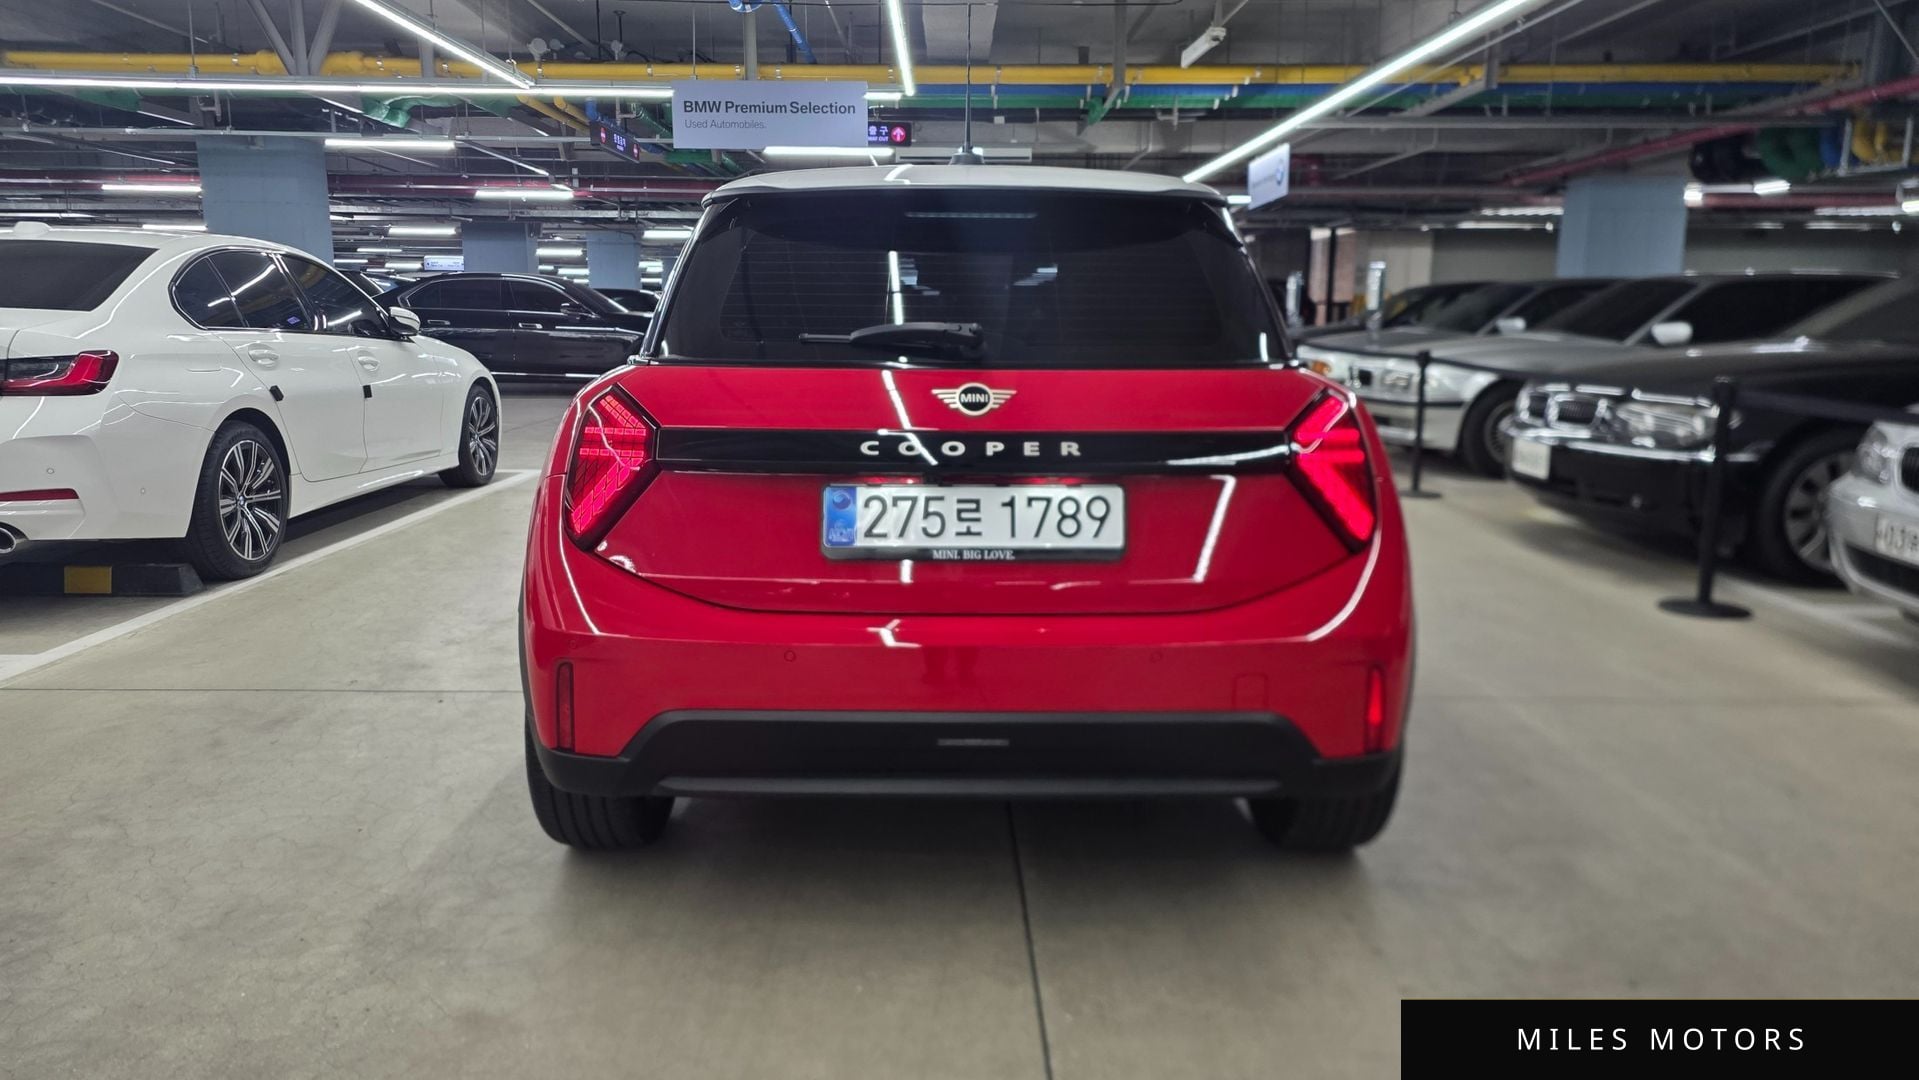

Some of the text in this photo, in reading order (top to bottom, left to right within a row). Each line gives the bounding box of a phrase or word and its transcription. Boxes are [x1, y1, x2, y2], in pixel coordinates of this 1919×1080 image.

[683, 100, 856, 114] BMW Premium Selection
[684, 119, 767, 129] Used Automobiles.
[960, 393, 989, 403] MINI
[860, 441, 1081, 456] COOPER
[863, 495, 1111, 538] 275로 1789
[932, 549, 1015, 560] MINI. BIG LOVE.
